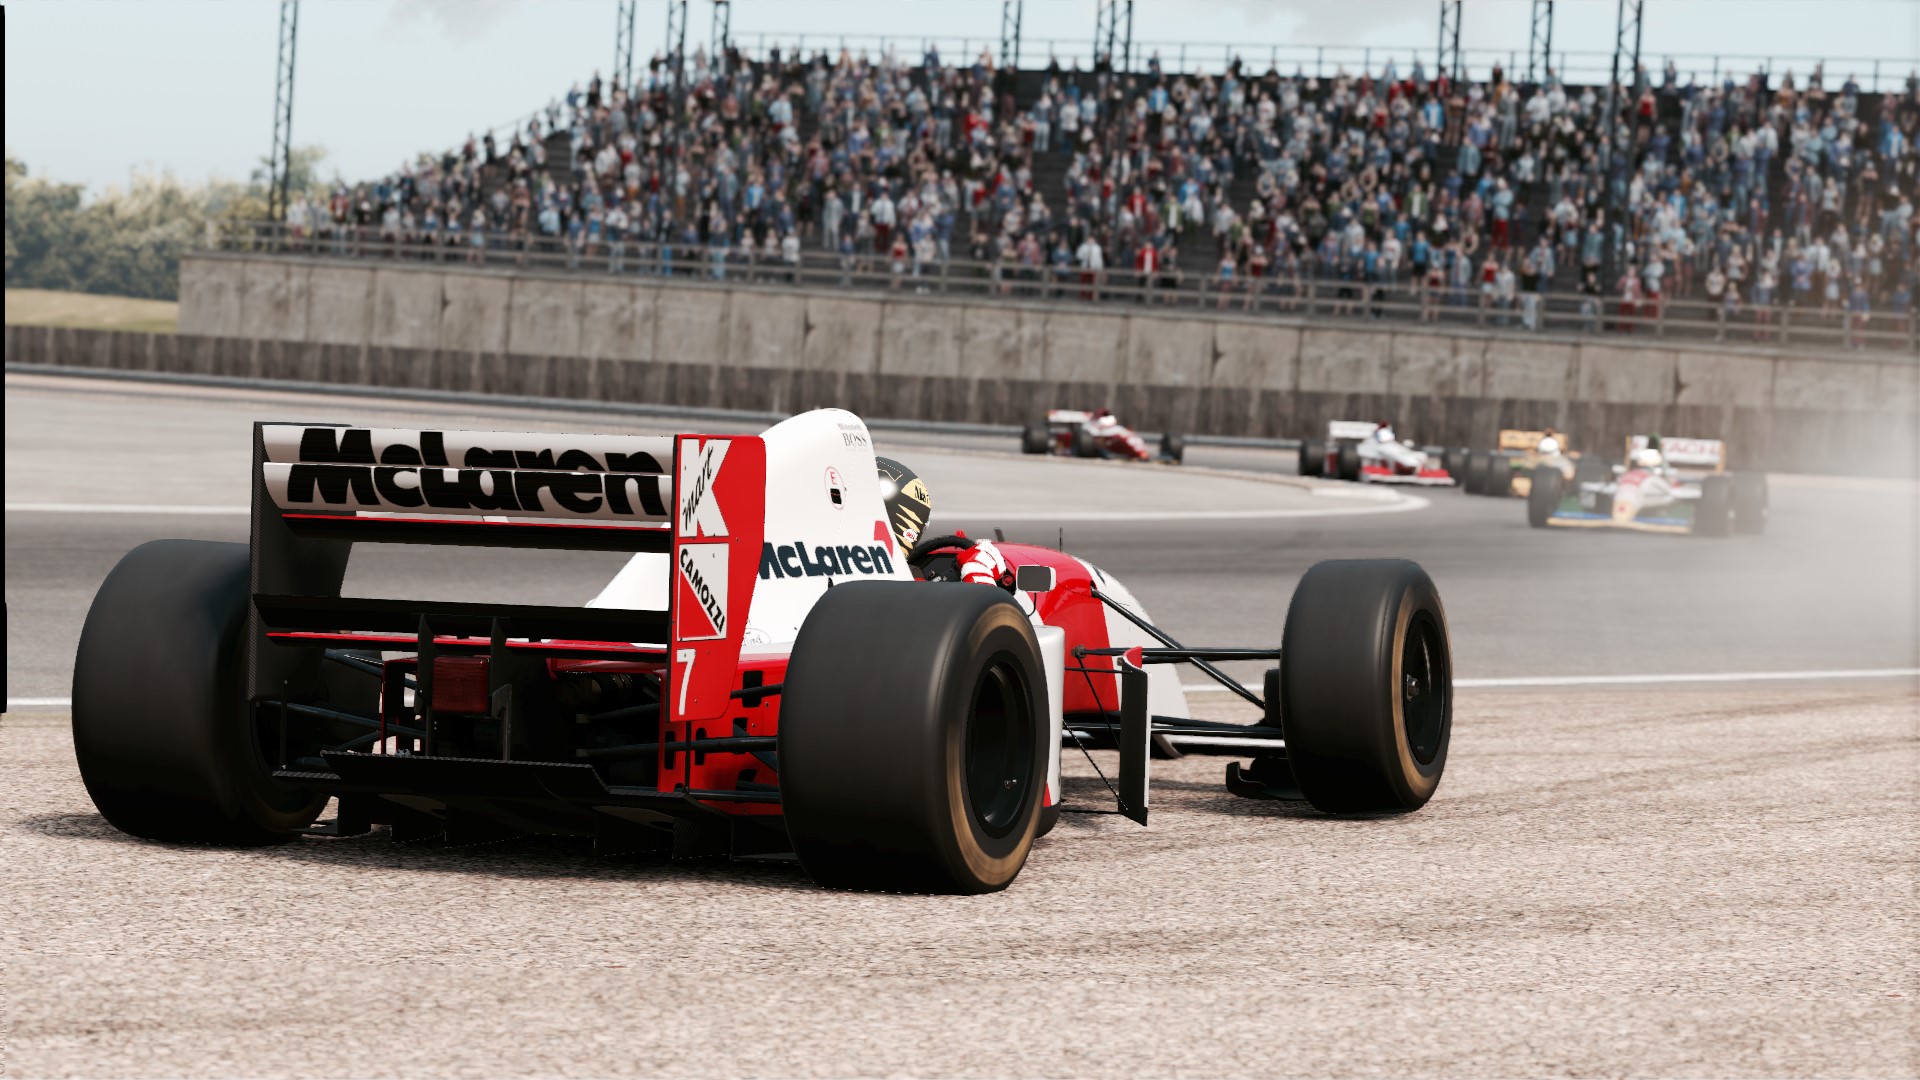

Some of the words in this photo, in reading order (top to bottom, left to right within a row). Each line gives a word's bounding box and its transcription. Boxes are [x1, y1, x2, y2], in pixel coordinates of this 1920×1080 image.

[288, 428, 668, 516] McLaren
[841, 432, 868, 447] BOSS
[680, 548, 725, 634] CAMOZZI
[757, 541, 895, 580] McLaren
[676, 648, 696, 716] 7
